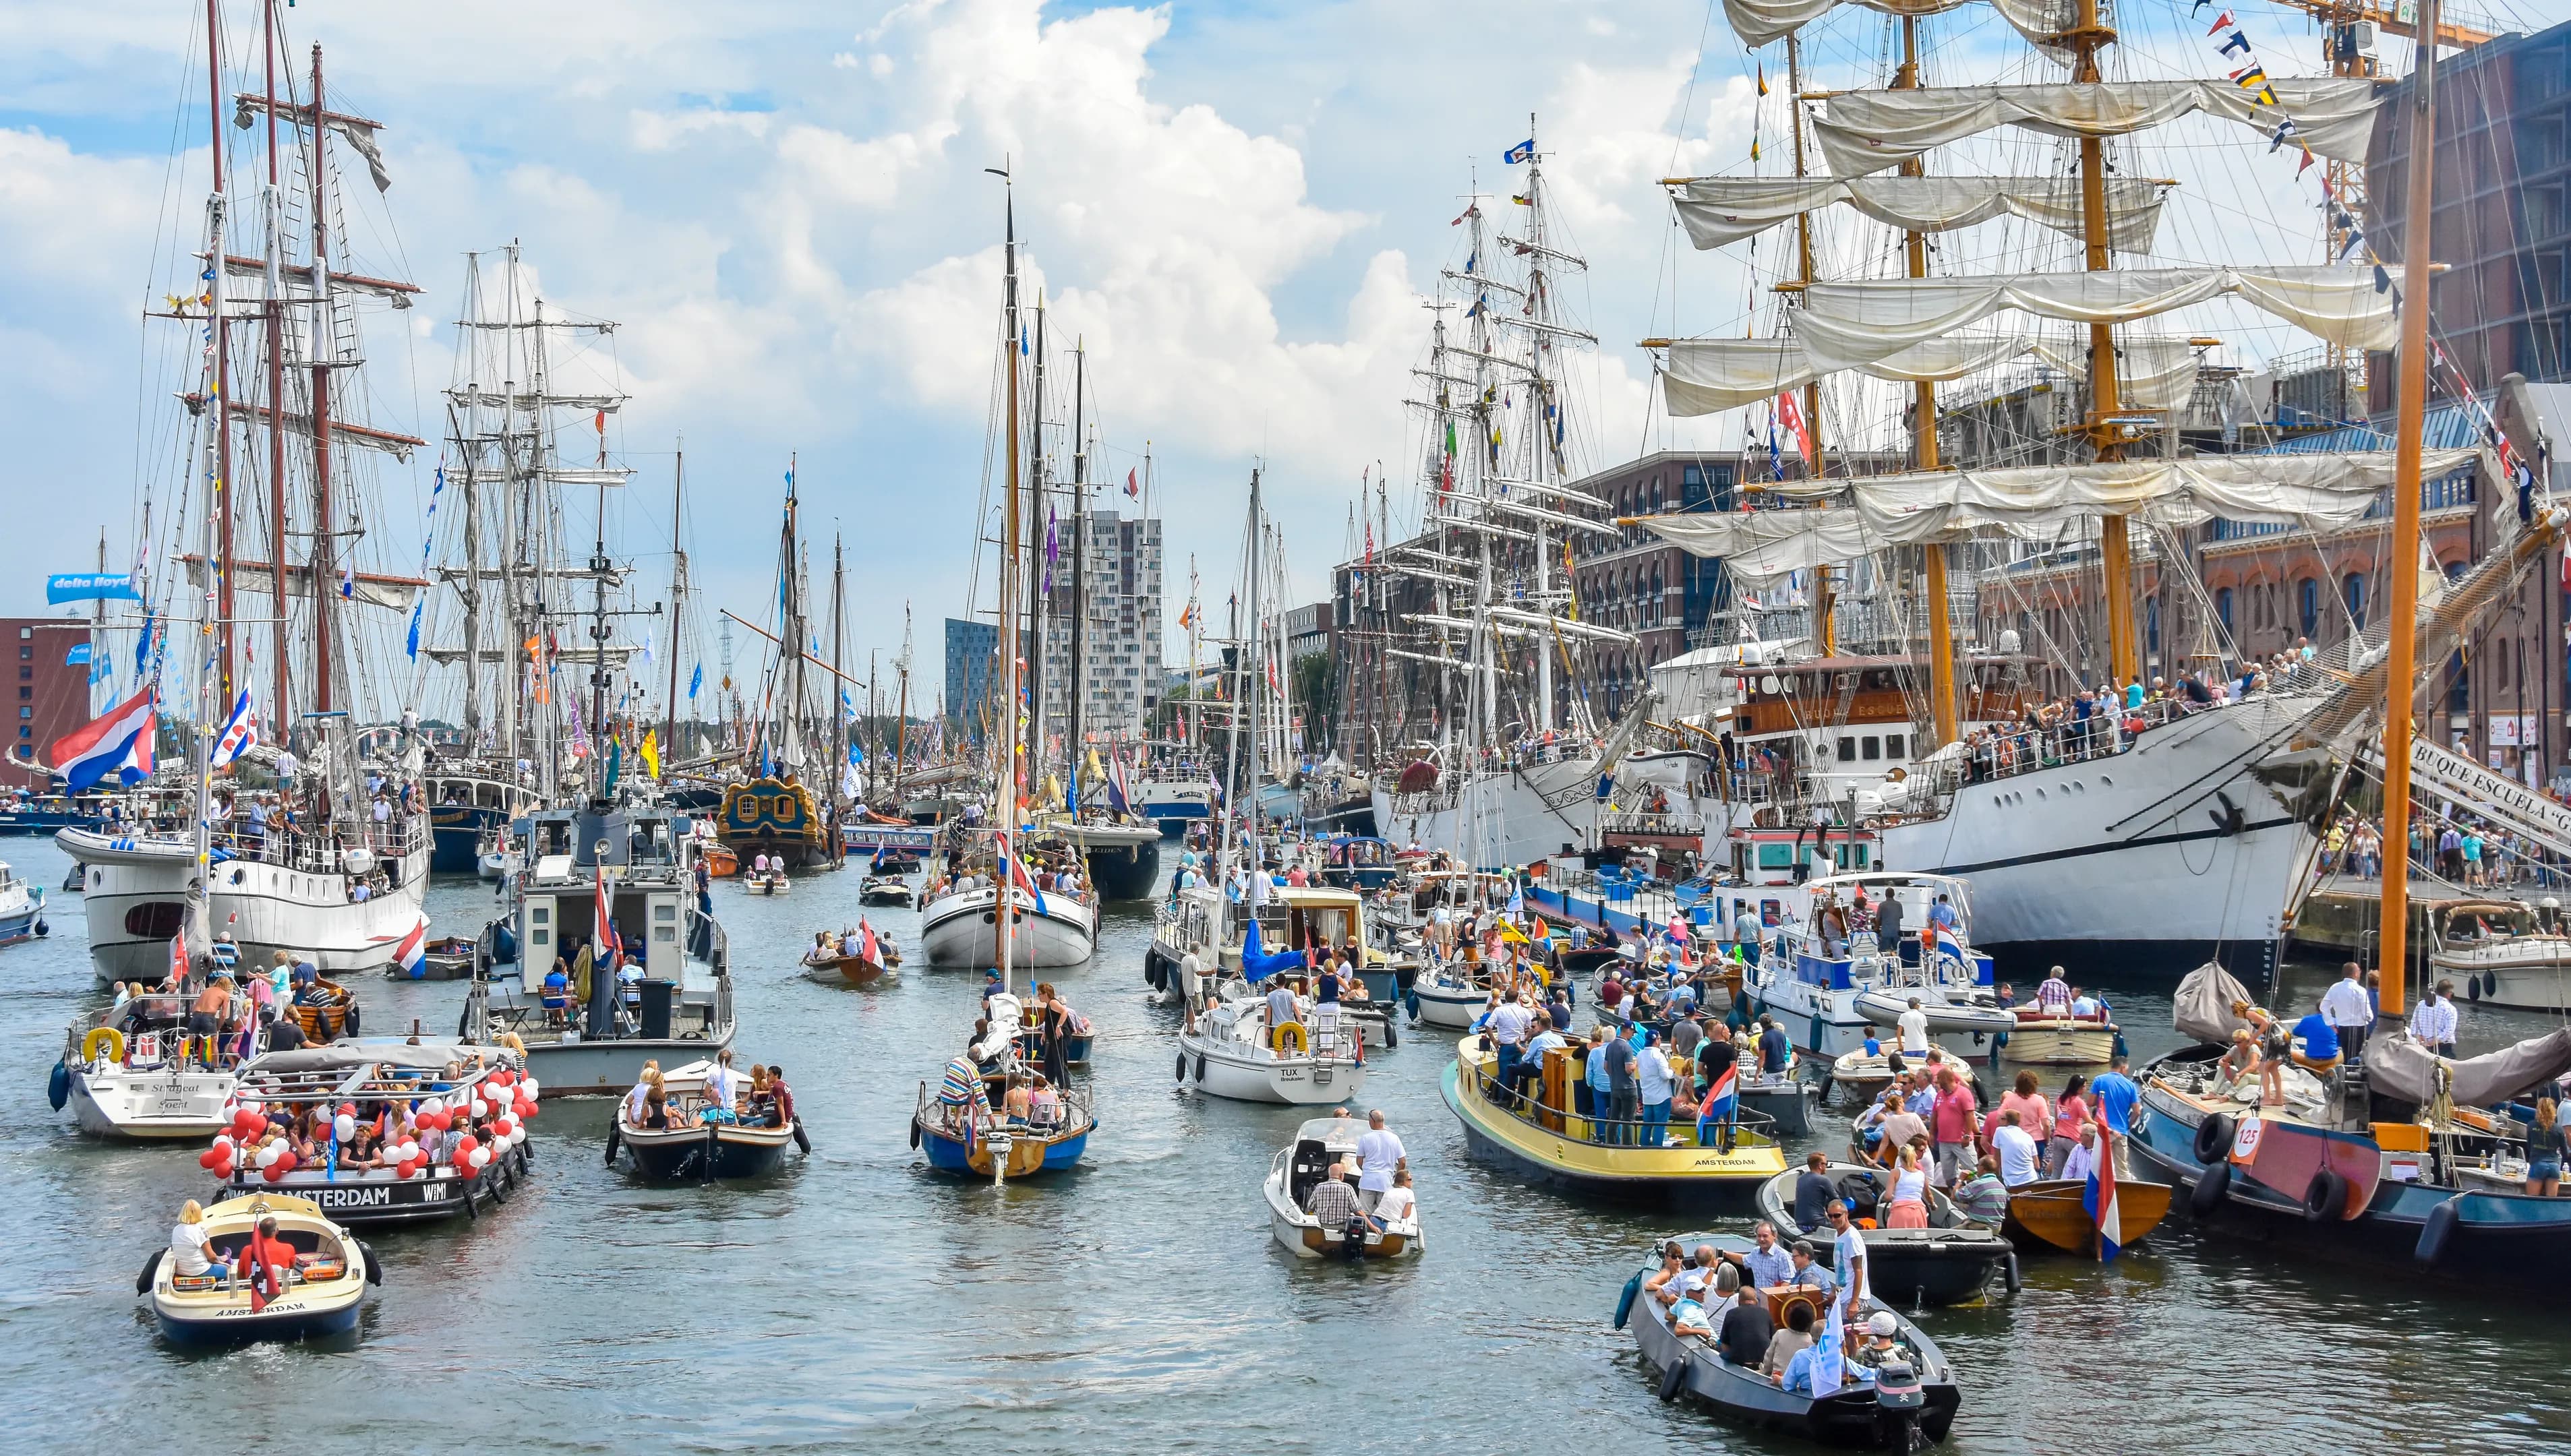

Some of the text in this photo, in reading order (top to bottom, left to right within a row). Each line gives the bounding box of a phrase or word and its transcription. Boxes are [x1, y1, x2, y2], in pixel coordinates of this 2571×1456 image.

[54, 577, 130, 588] delta lloyd
[2414, 746, 2472, 783] BUQUE
[2473, 774, 2545, 820] ESCUELA
[1280, 1068, 1297, 1076] TUX
[152, 1084, 199, 1093] Straycat
[158, 1100, 187, 1109] Soest
[2239, 1129, 2258, 1145] 125
